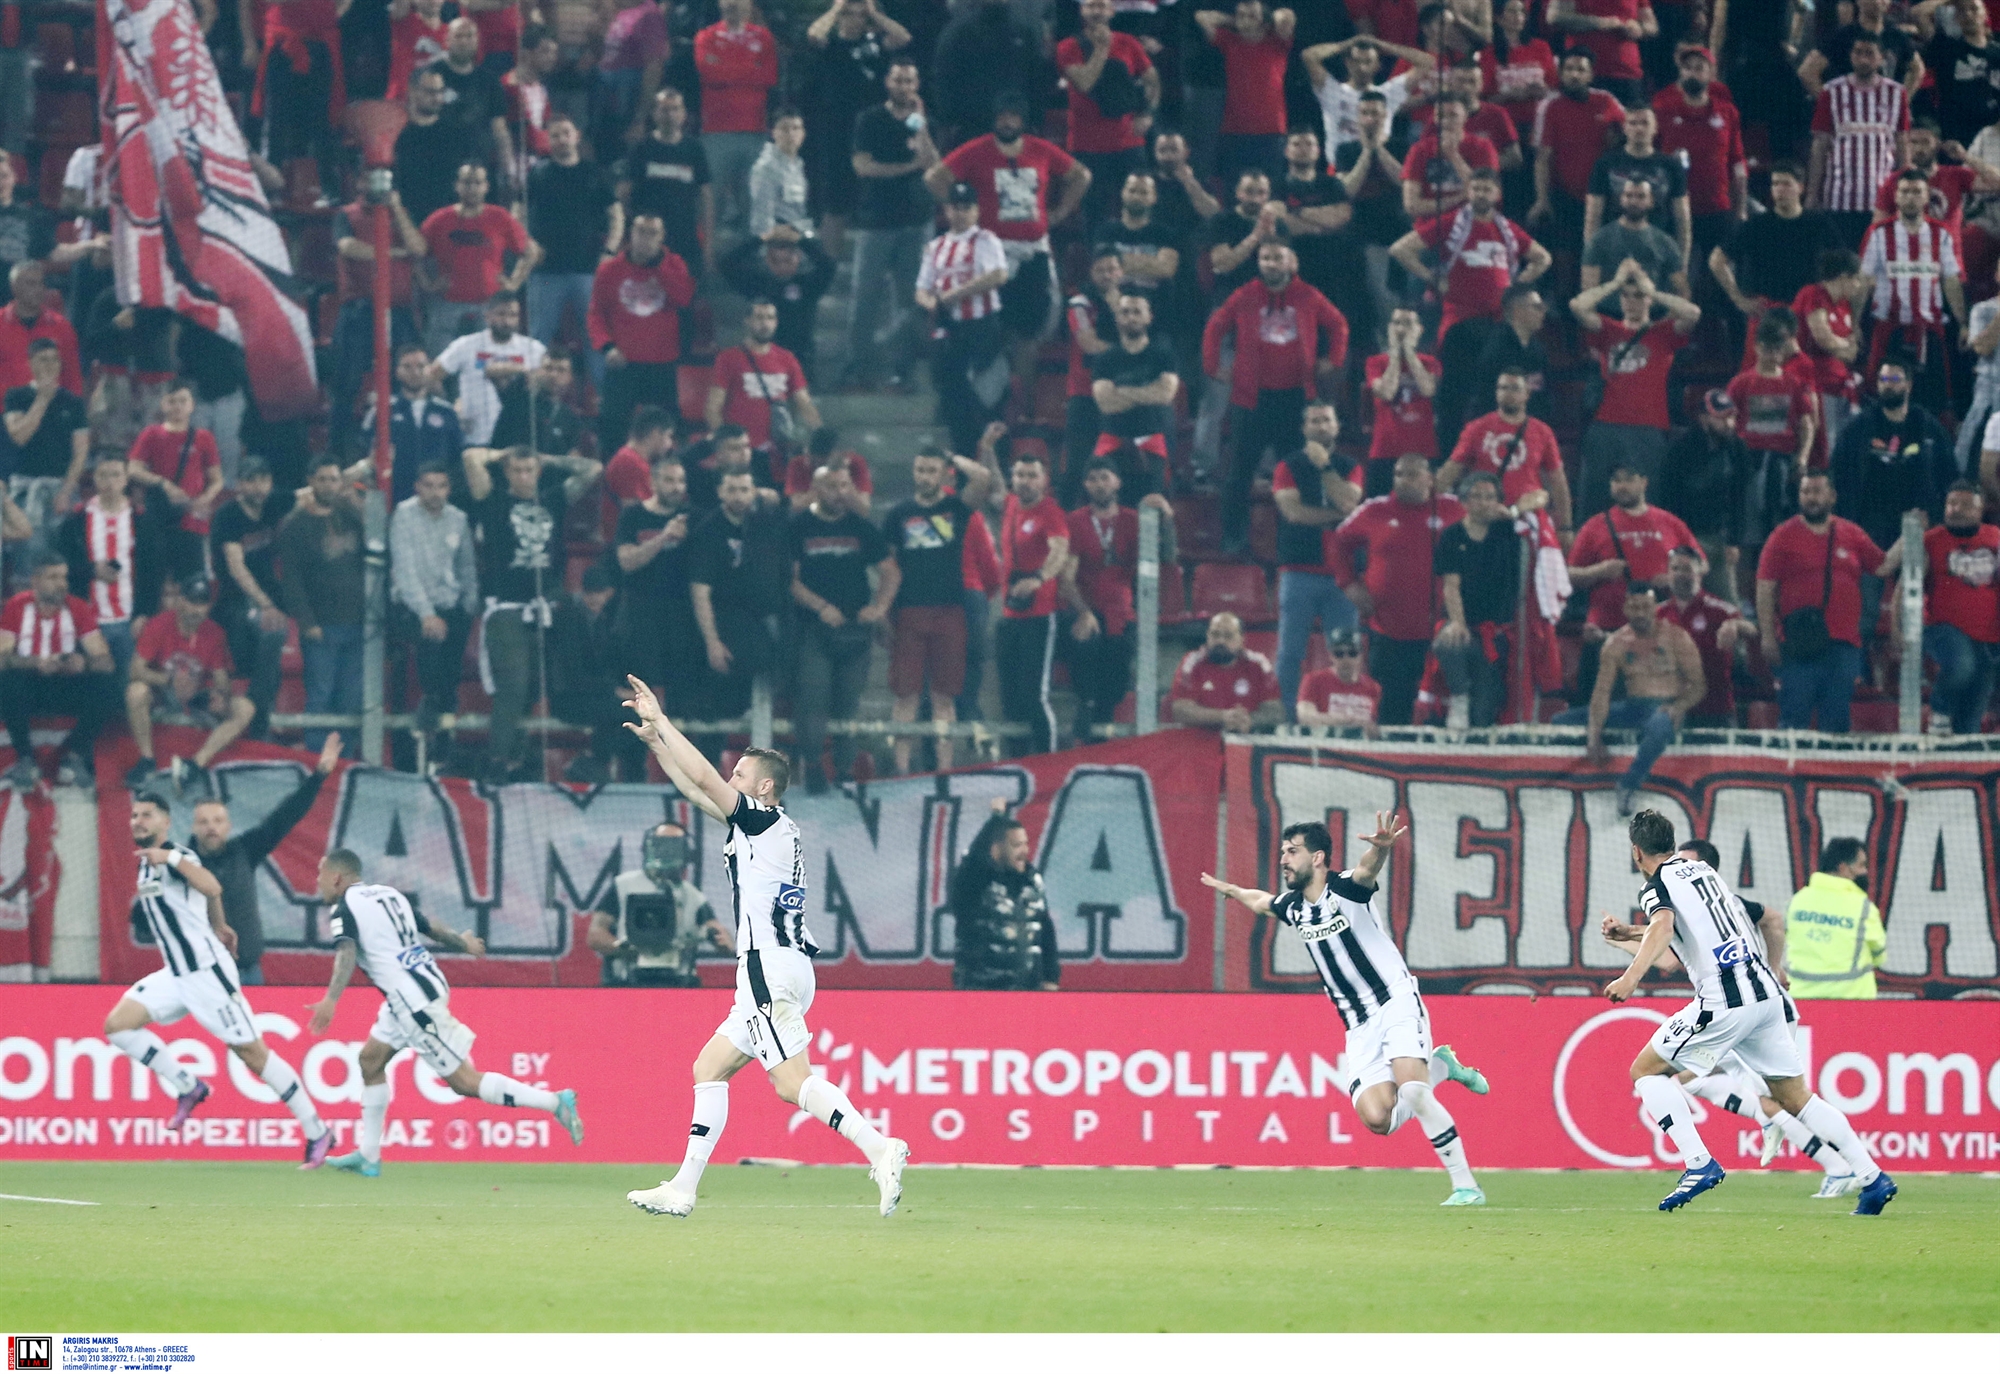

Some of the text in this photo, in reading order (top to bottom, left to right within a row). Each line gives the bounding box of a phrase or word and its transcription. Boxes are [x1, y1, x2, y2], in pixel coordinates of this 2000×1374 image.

[512, 1052, 551, 1077] BY
[861, 1047, 1350, 1099] METROPOLITAN
[478, 1119, 551, 1148] 1051
[862, 1107, 1353, 1144] HOSPITAL
